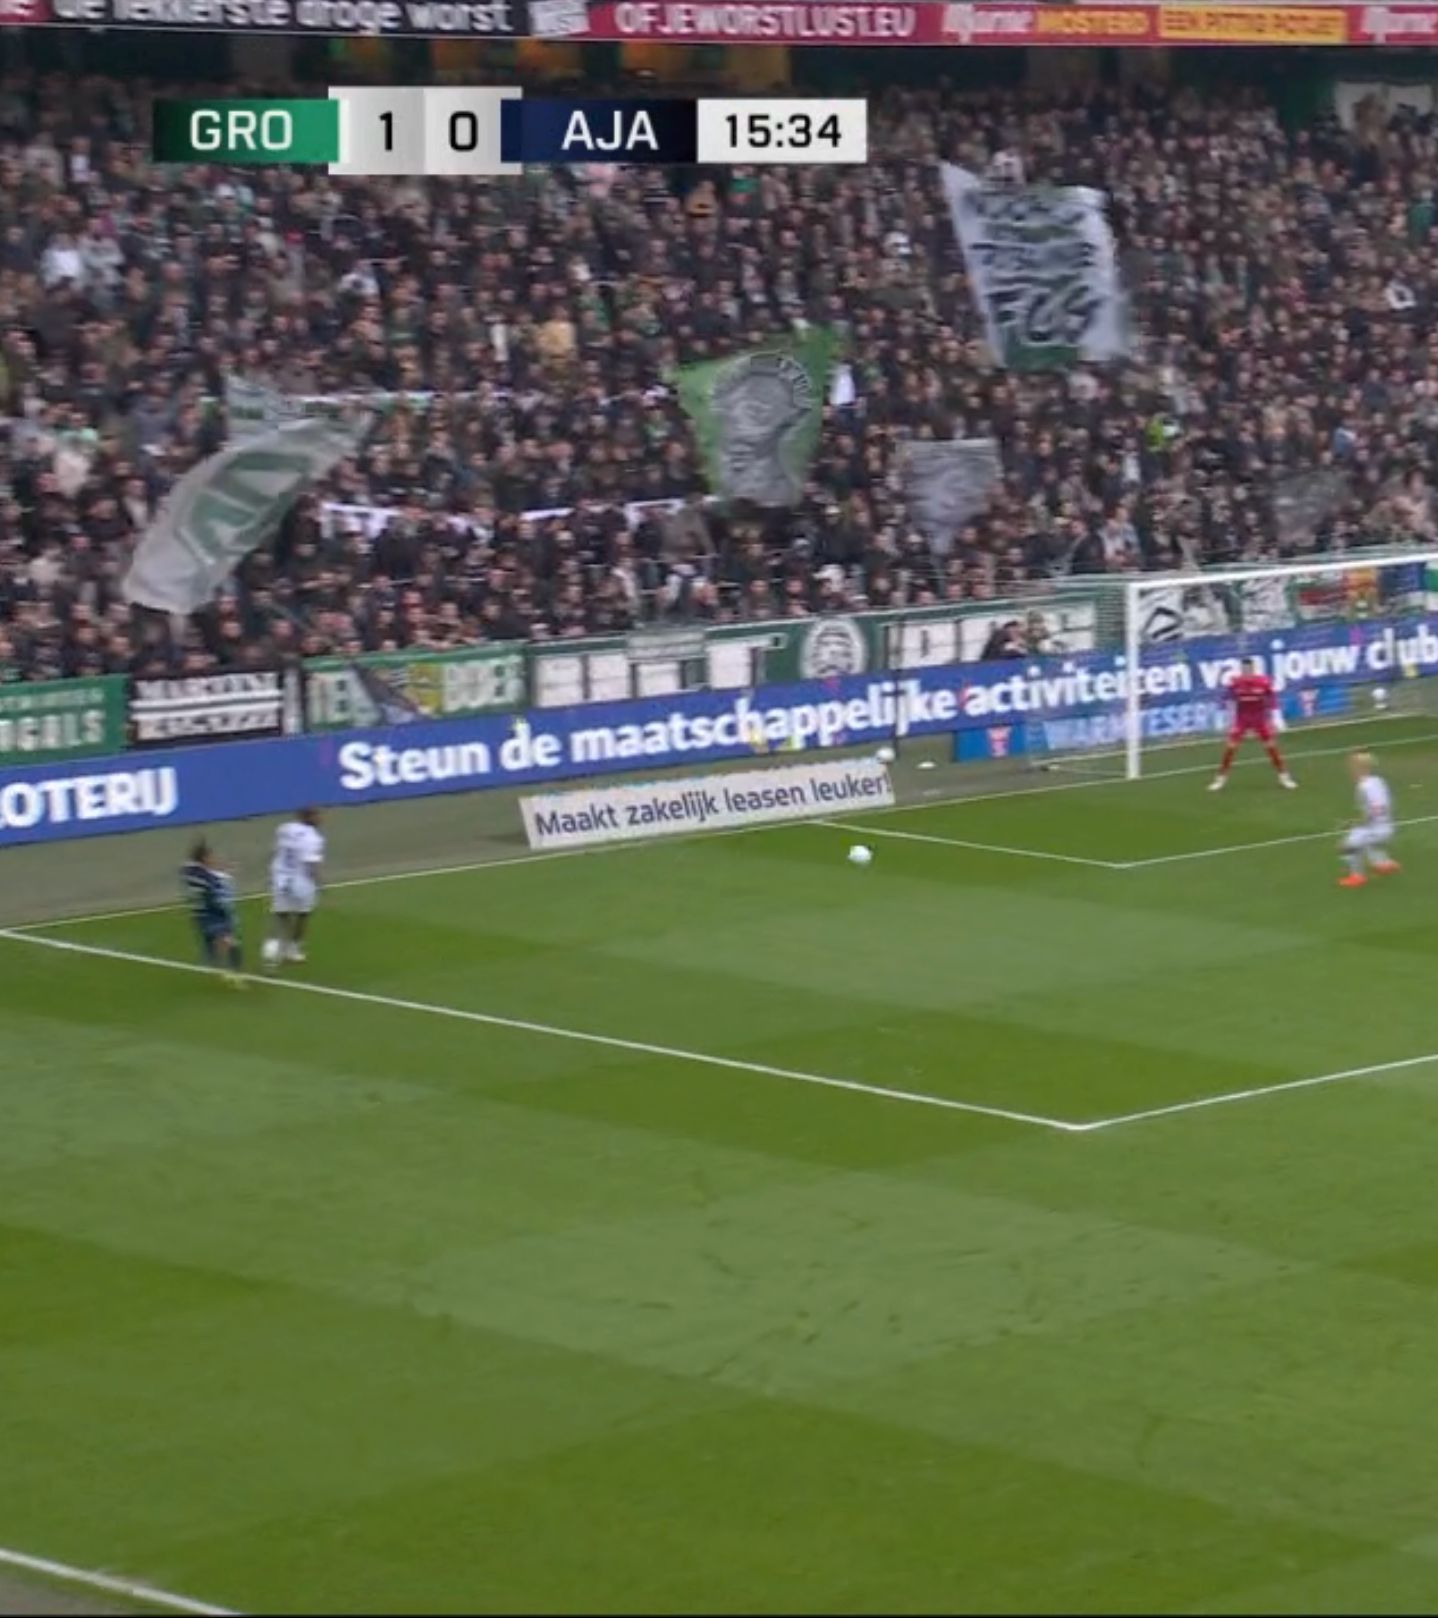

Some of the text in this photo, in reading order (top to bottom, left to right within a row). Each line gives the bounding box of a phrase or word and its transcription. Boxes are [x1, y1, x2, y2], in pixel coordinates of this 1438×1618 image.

[297, 0, 401, 36] droge
[408, 0, 513, 32] worst
[338, 742, 490, 791] Steun
[499, 717, 562, 771] de
[571, 680, 957, 764] maatschappelijke
[1271, 638, 1361, 692] jouw
[0, 766, 179, 830] OTERIJ
[535, 770, 893, 837] Maakt zakelijk leasen leuker!
